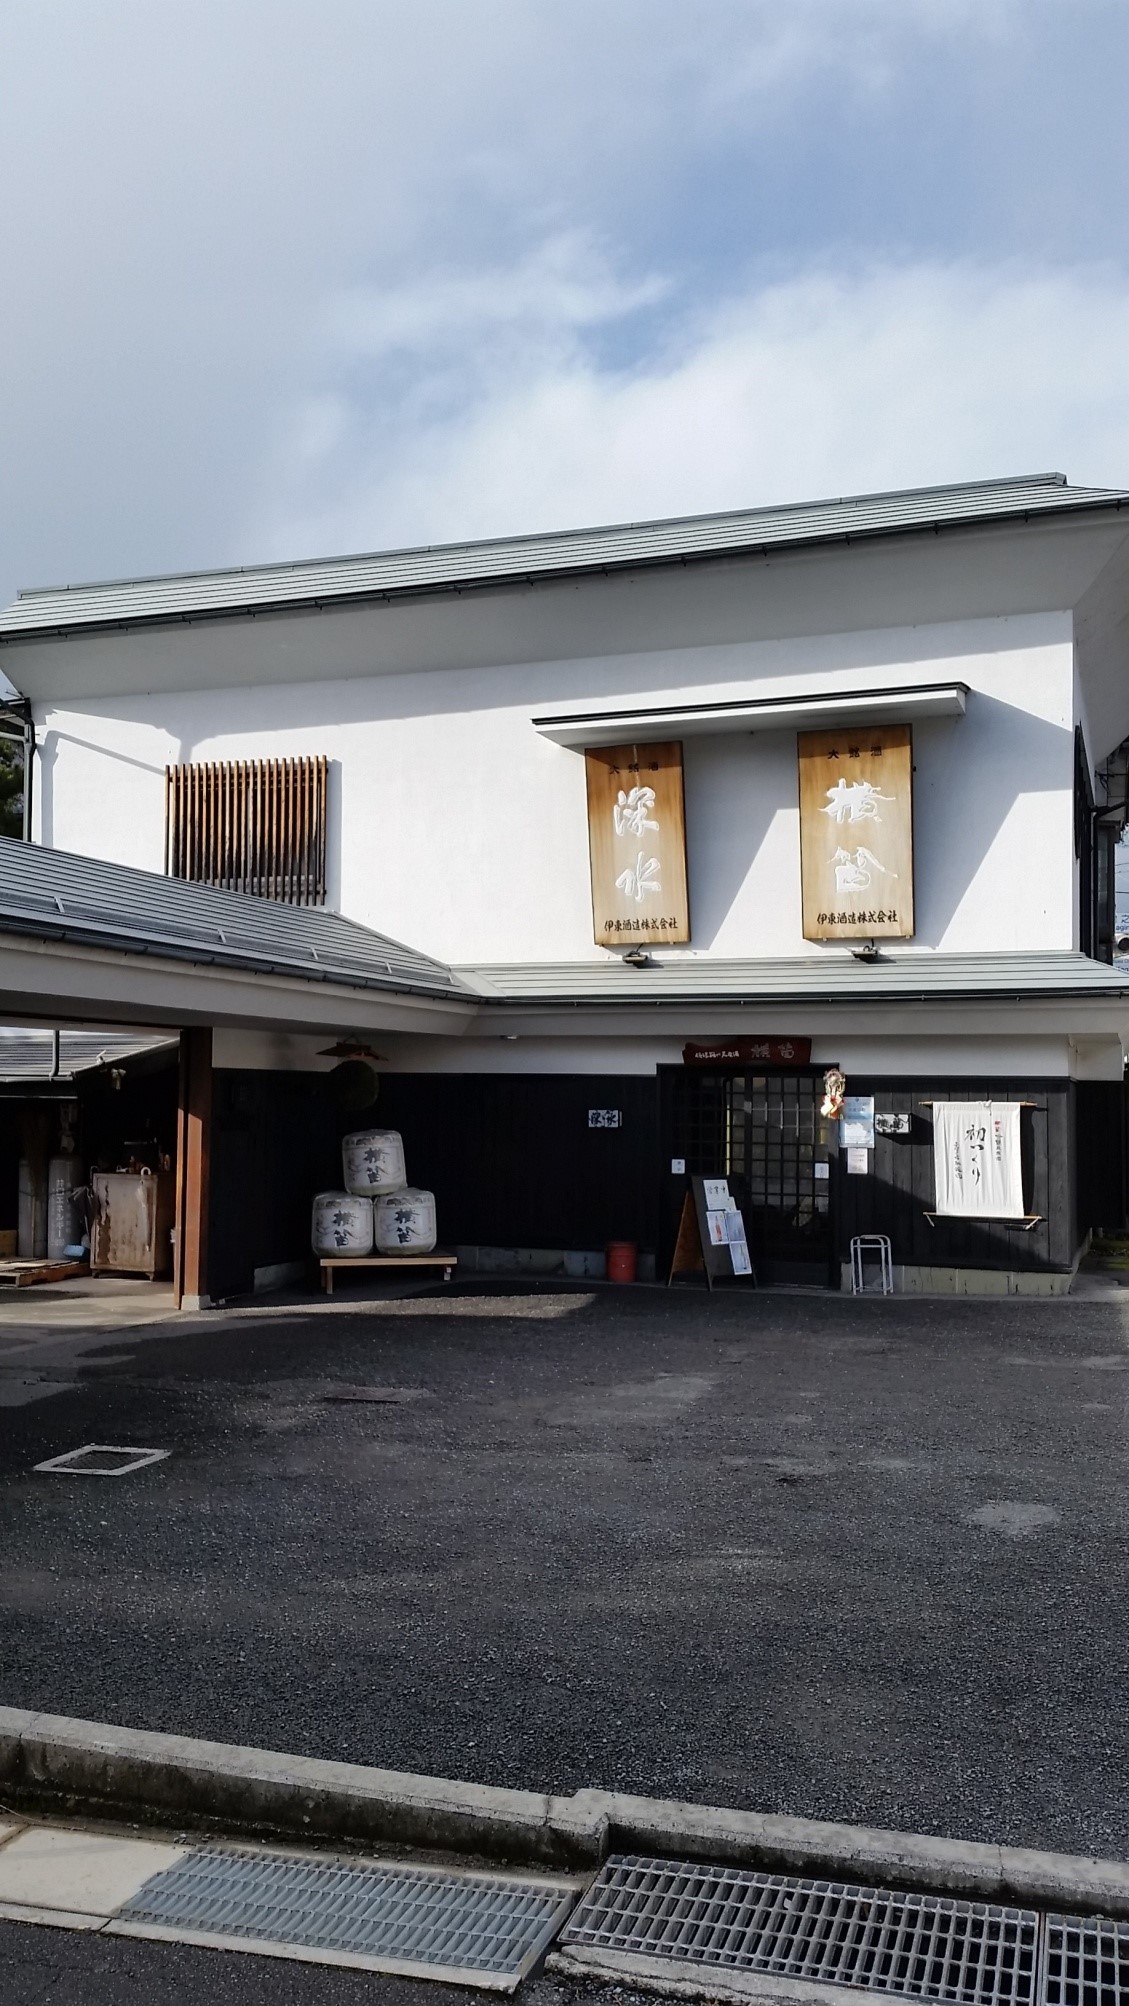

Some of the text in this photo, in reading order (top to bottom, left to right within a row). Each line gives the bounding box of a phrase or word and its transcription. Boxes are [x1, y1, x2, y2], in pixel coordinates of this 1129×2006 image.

[827, 746, 883, 759] 大銘酒
[609, 761, 659, 775] 大銘酒
[818, 777, 899, 894] 横笛
[604, 917, 679, 932] 伊東酒造株式会社
[816, 910, 898, 925] 伊東酒造株式会社
